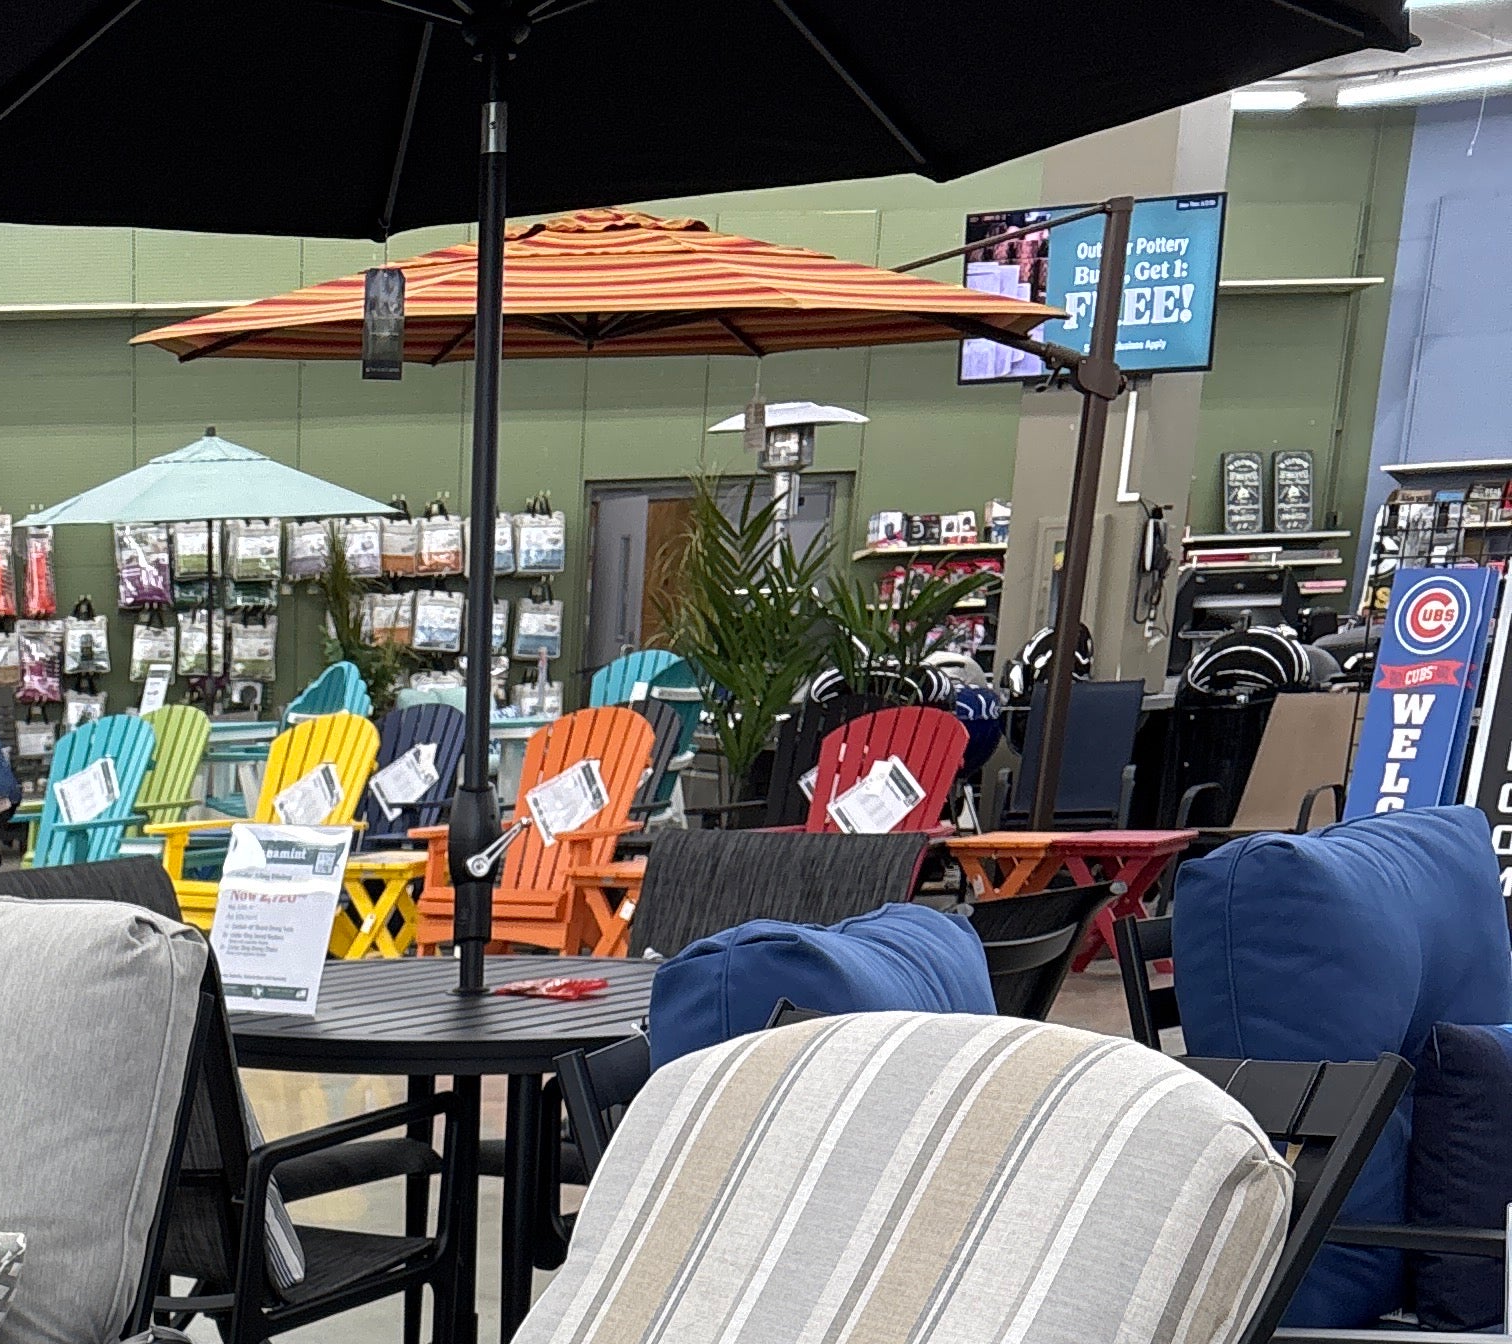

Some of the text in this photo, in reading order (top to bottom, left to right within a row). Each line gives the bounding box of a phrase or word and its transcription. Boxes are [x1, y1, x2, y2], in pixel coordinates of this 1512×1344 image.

[1076, 236, 1189, 260] Outr Pottery
[1134, 262, 1170, 280] Get
[1062, 283, 1195, 330] FEE!
[1410, 591, 1455, 638] CUBS
[1404, 665, 1436, 686] CUBS
[230, 890, 257, 901] Now
